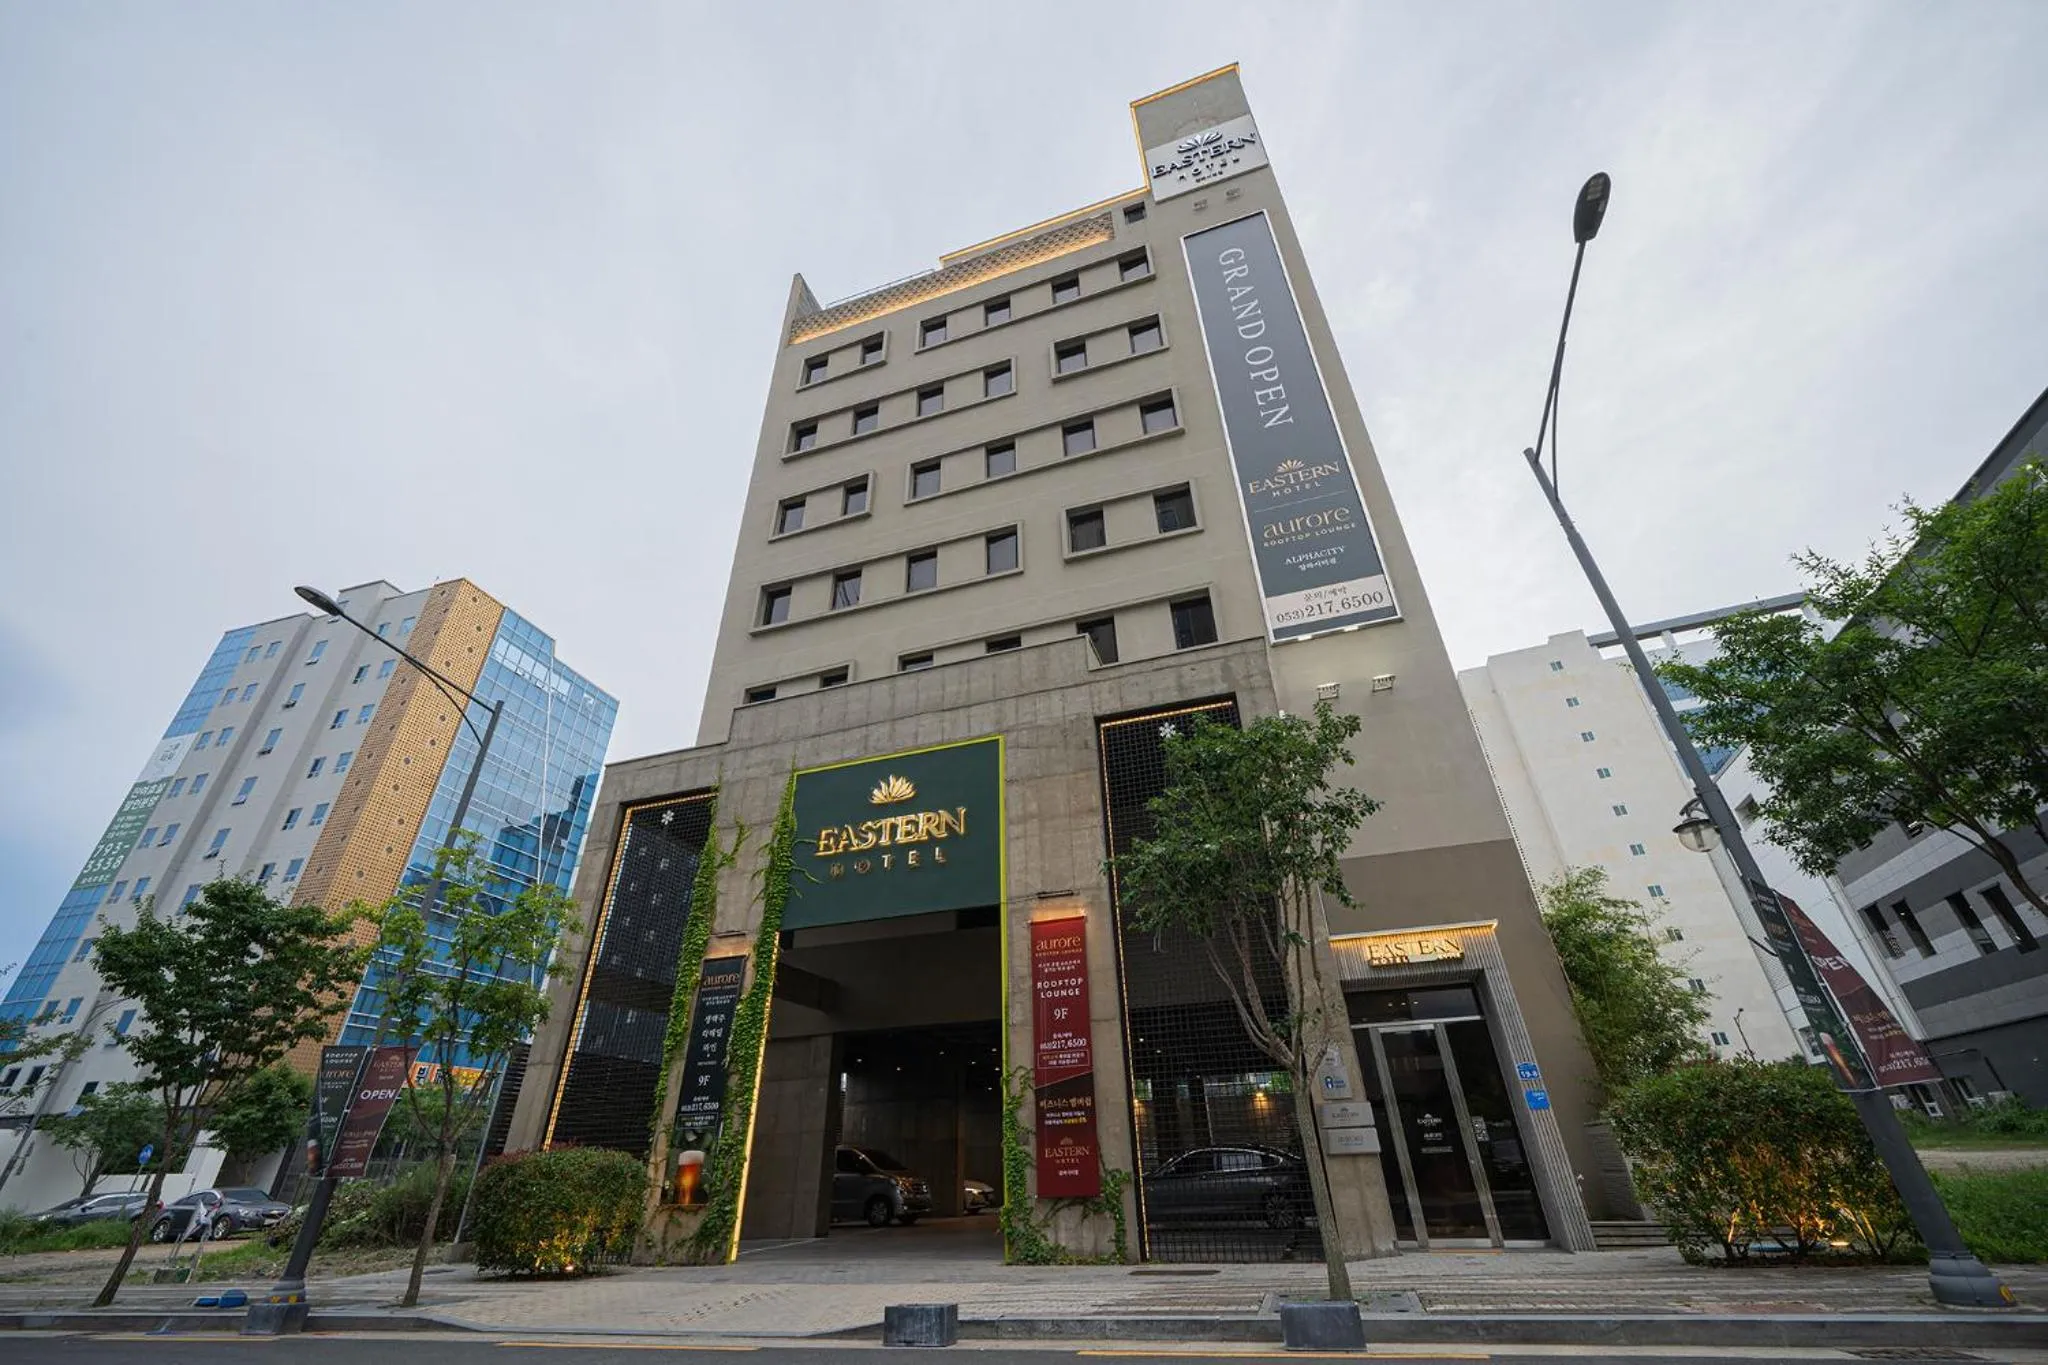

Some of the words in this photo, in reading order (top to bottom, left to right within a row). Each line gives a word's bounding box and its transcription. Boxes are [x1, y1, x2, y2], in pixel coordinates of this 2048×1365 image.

[1151, 133, 1256, 179] EASTERN
[1219, 247, 1265, 340] GRAND
[1245, 346, 1294, 429] OPEN
[1248, 461, 1341, 495] EASTERN
[1272, 480, 1321, 498] HOTEL
[1263, 507, 1350, 539] aurore
[1263, 531, 1311, 548] ROOFTOP
[1315, 522, 1356, 537] LOUNGE
[1284, 545, 1345, 566] ALPHACITY
[1276, 591, 1384, 623] 053)217.6500
[814, 806, 967, 857] EASTERN
[830, 847, 947, 879] HOTEL
[1036, 936, 1081, 951] aurore
[1368, 939, 1462, 958] EASTERN
[1372, 955, 1409, 966] HOTEL
[703, 972, 740, 987] aurore
[1037, 978, 1083, 990] ROOFTOP
[1041, 988, 1080, 999] LOUNGE
[1054, 1008, 1069, 1020] 9F
[698, 1075, 711, 1087] 9F
[360, 1089, 396, 1100] OPEN
[1045, 1146, 1089, 1158] EASTERN
